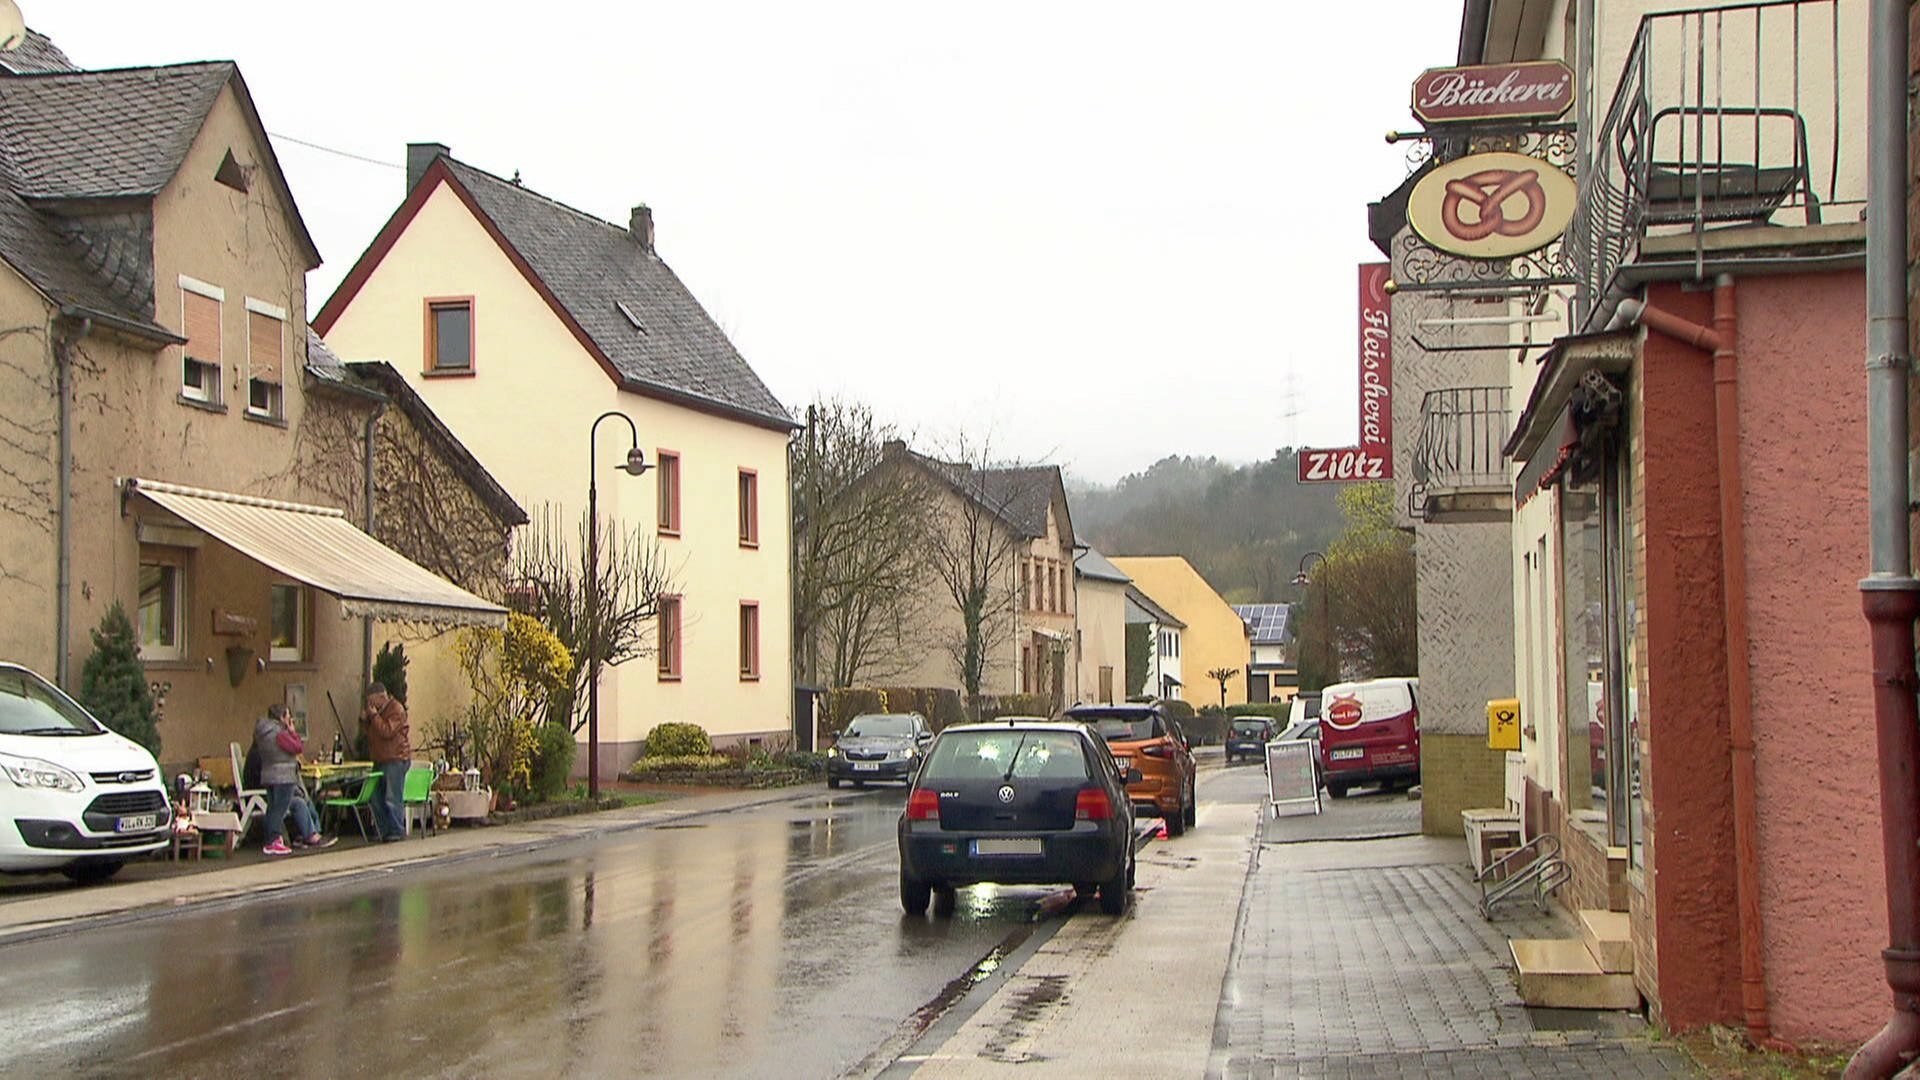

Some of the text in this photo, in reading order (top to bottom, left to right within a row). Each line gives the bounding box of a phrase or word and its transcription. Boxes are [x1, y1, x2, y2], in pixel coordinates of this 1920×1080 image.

[1420, 69, 1569, 109] Bäckerei
[1363, 308, 1389, 444] Fleischerei
[1306, 452, 1384, 480] Ziltz
